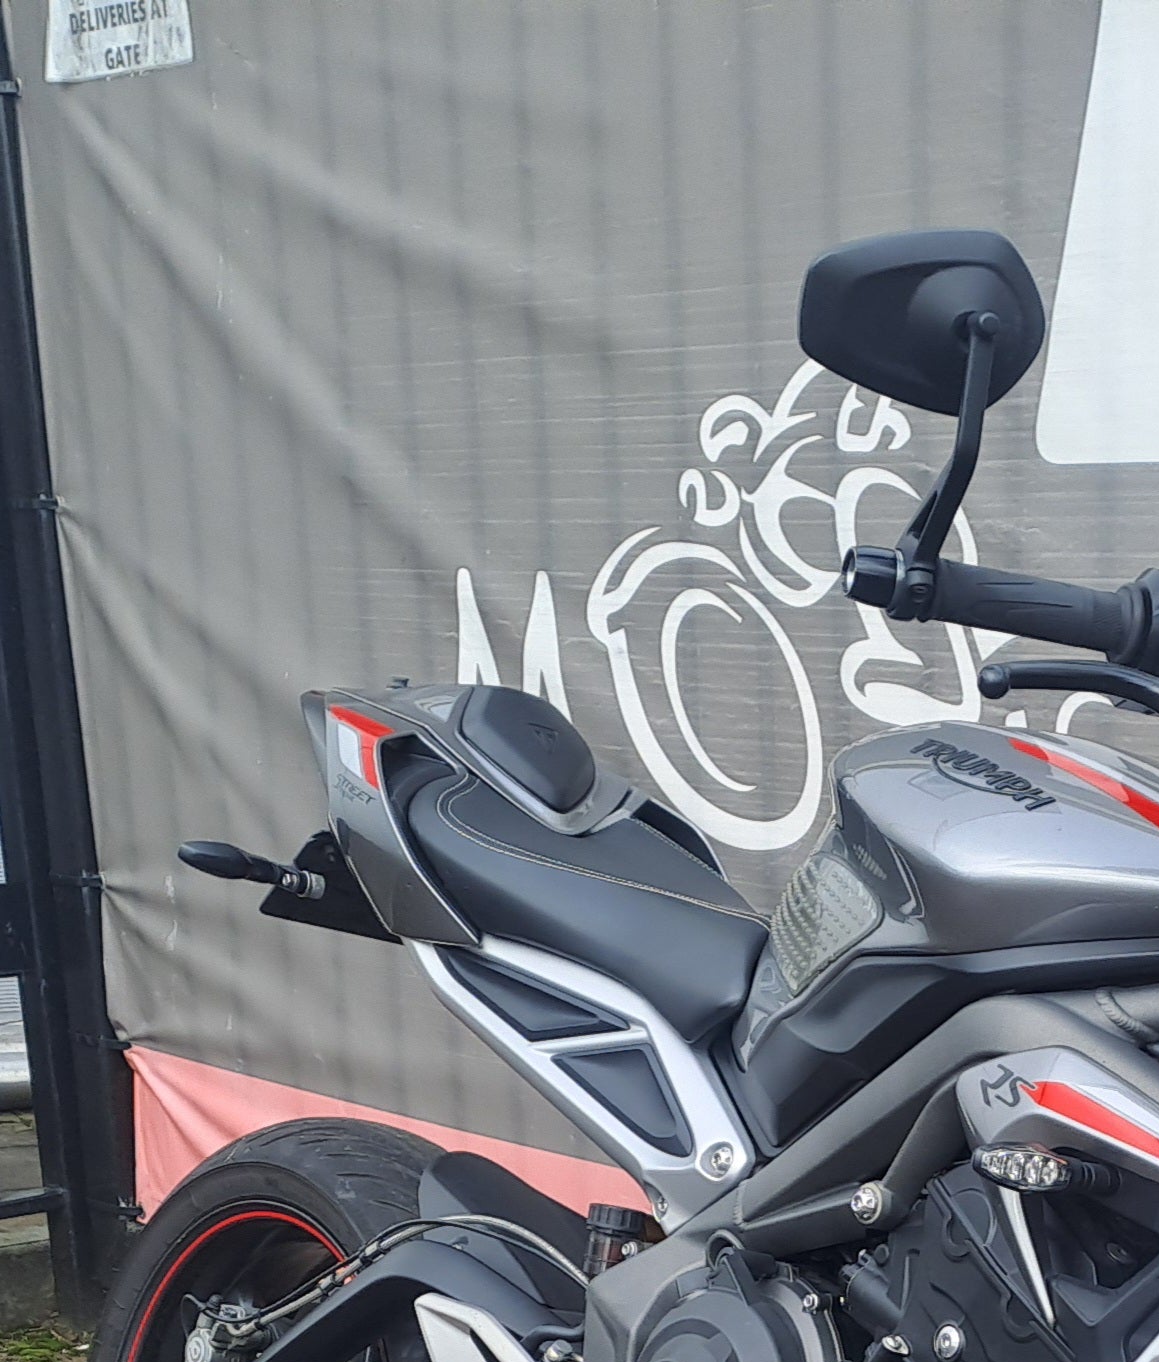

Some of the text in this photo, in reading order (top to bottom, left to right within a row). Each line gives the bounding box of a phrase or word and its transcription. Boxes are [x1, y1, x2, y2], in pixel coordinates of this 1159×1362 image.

[69, 0, 169, 35] DELIVERIES AT
[104, 43, 142, 70] GATE
[910, 738, 1057, 811] TRIUMPH
